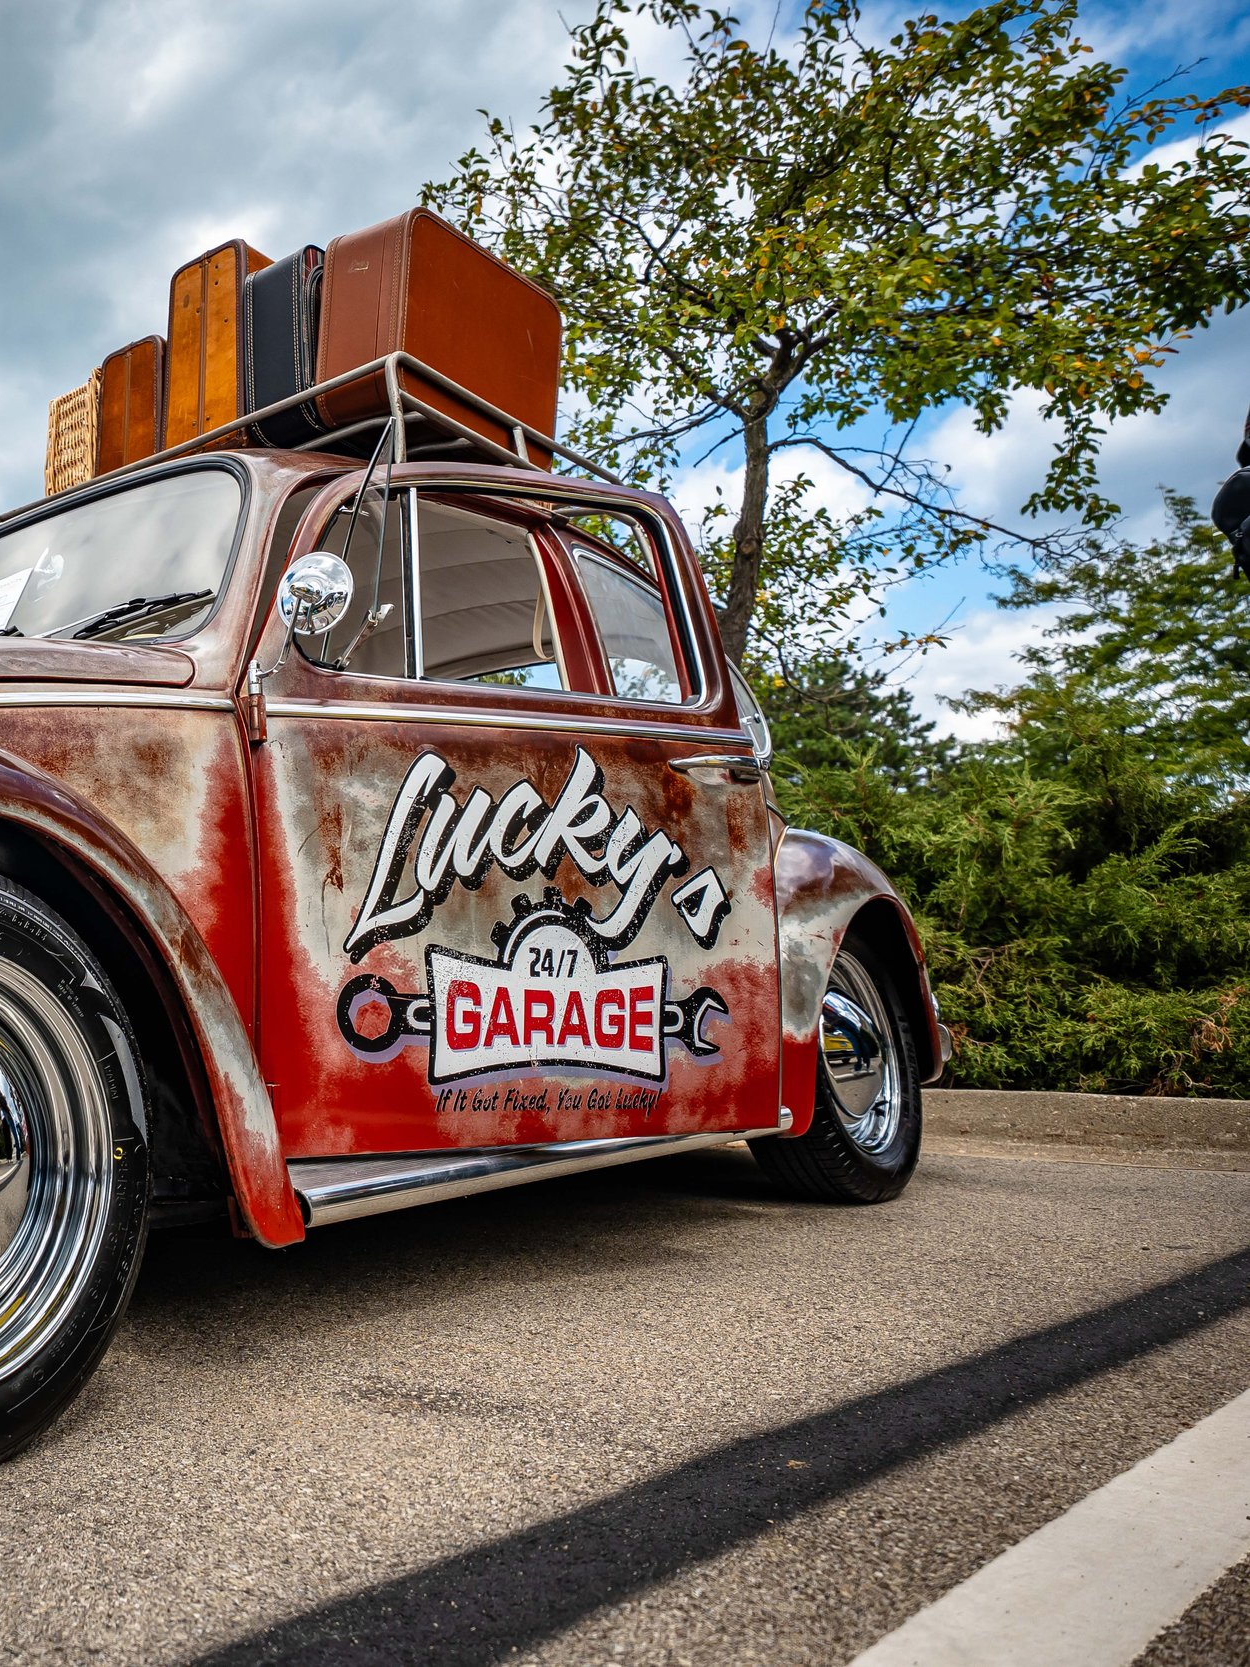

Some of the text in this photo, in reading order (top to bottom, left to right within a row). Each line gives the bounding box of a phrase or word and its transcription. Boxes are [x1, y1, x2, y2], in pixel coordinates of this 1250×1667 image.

[529, 947, 579, 978] 24/7
[445, 978, 655, 1052] GARAGE
[436, 1087, 663, 1117] If It Got Fixed, You Got Lucky!
